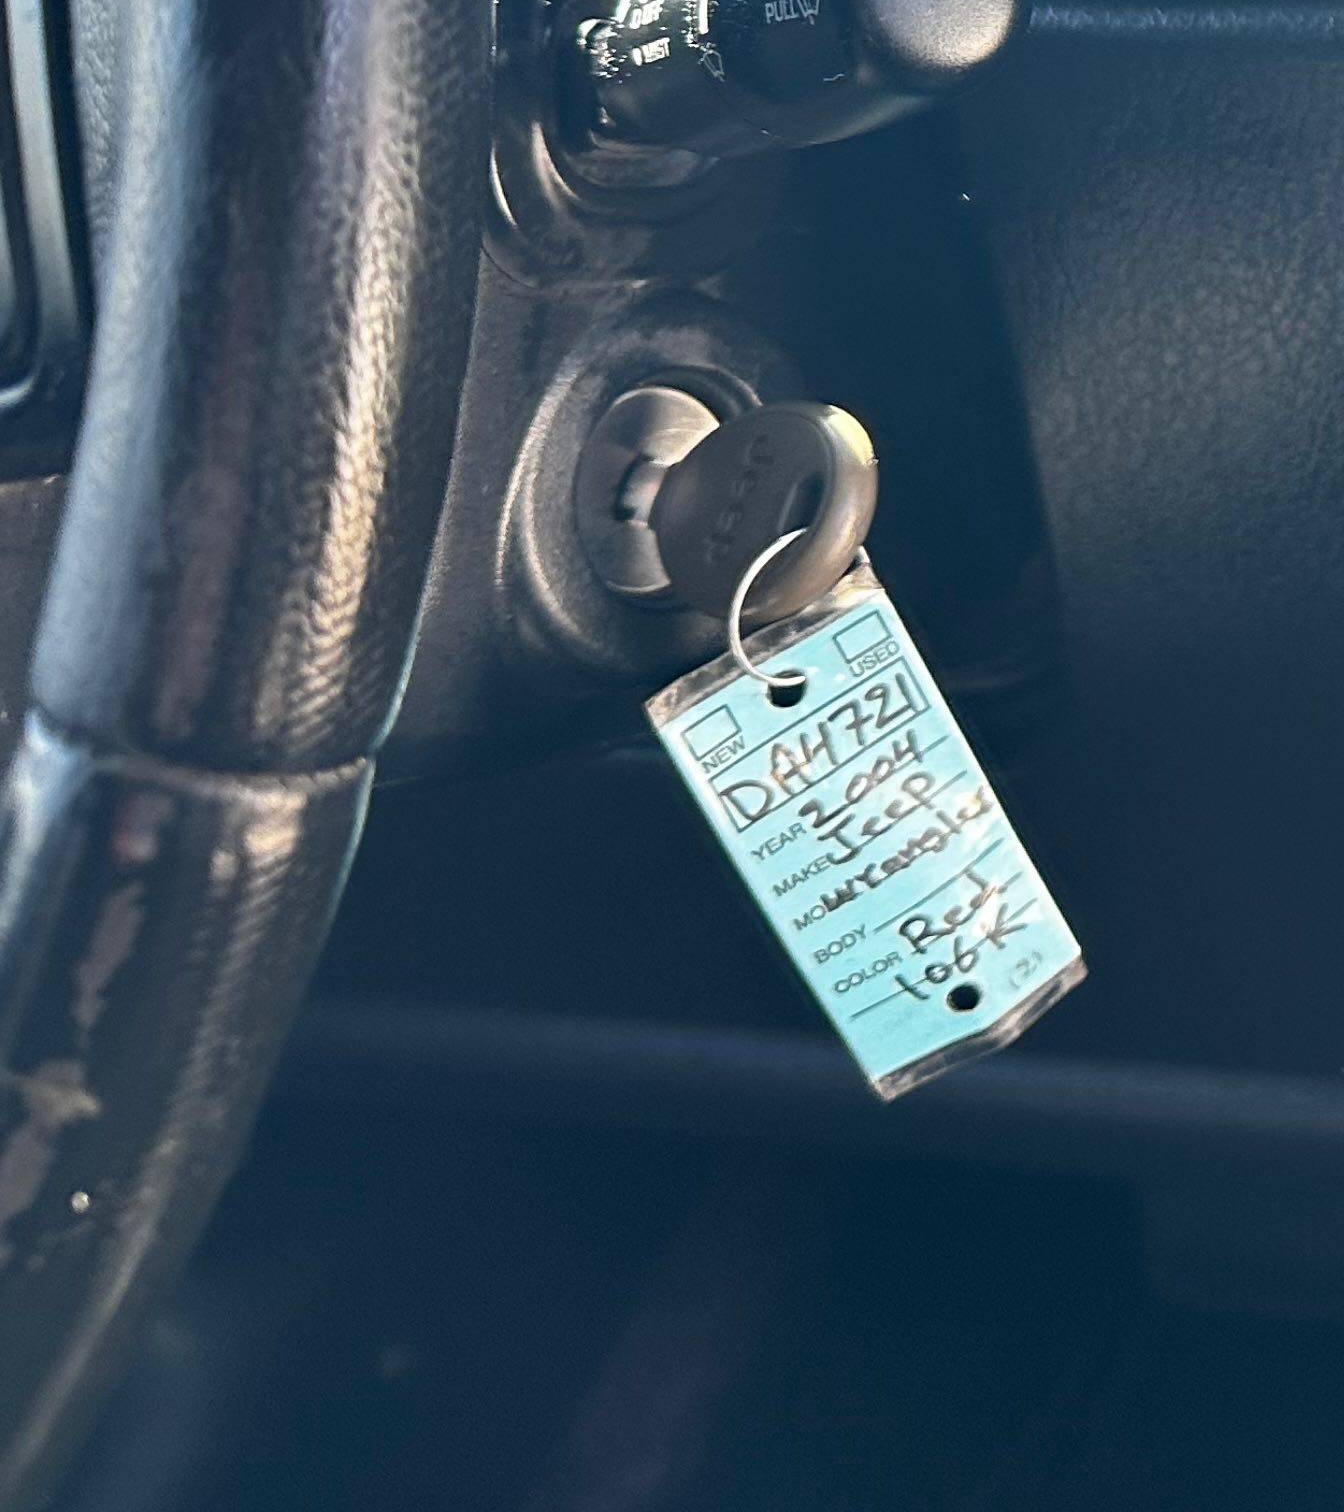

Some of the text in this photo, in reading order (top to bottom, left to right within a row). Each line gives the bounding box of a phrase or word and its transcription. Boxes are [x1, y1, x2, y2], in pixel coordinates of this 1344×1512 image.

[849, 641, 901, 678] USED
[701, 735, 746, 775] NEW
[751, 729, 924, 861] YEAR 2004
[772, 771, 936, 897] MAKE Jeep
[814, 924, 868, 965] BODY
[834, 951, 901, 994] COLOR
[899, 869, 1008, 955] Red
[895, 902, 1028, 1001] 106K
